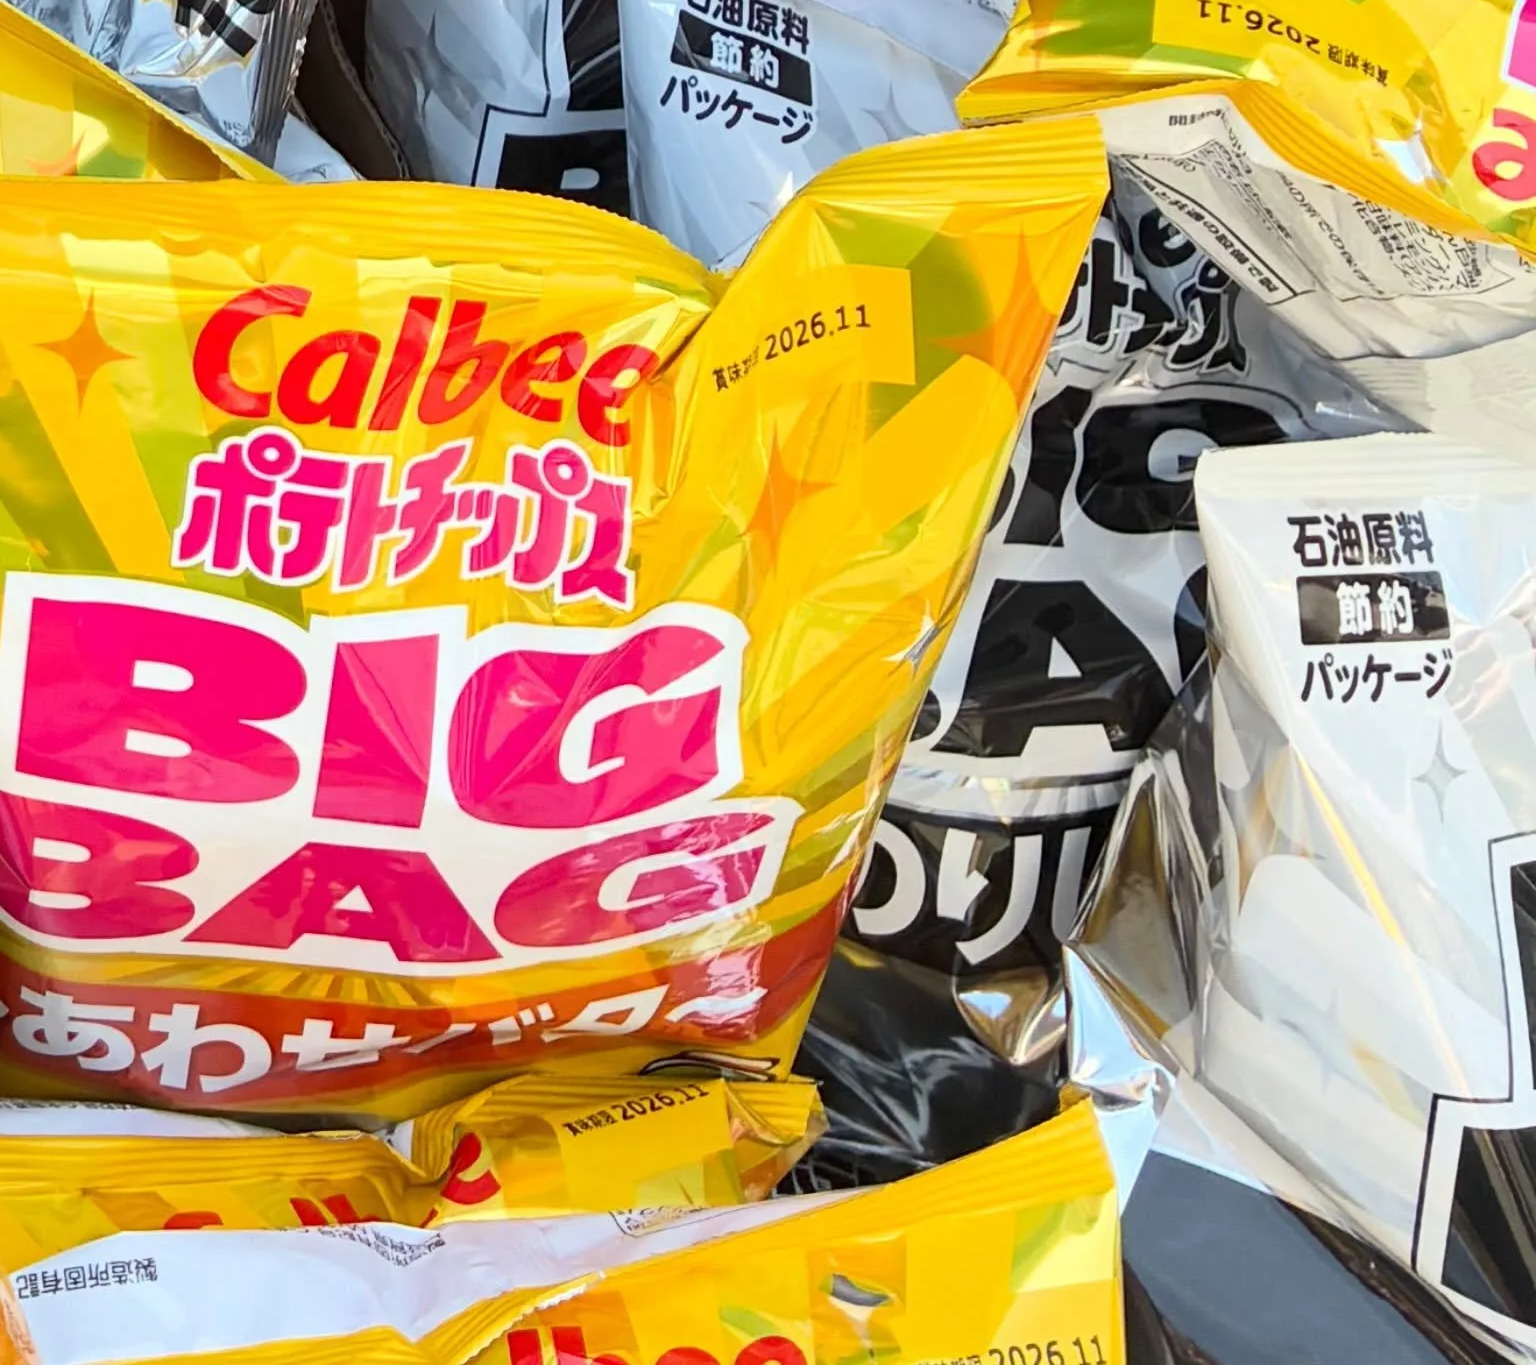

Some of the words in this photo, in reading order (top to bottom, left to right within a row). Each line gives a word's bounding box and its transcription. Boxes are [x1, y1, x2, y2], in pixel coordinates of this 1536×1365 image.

[710, 30, 782, 89] 節約
[660, 74, 815, 145] パッケージ
[765, 302, 873, 362] 2026.11
[192, 283, 658, 445] Calbee
[987, 384, 1288, 547] IG
[173, 426, 637, 612] ポテトチップス
[1288, 512, 1436, 567] 石油原料
[1334, 579, 1416, 635] 節約
[1300, 648, 1453, 705] パッケージ
[14, 596, 727, 831] BIG
[613, 1080, 708, 1121] 2026.11
[16, 1257, 160, 1301] 製造所固有記
